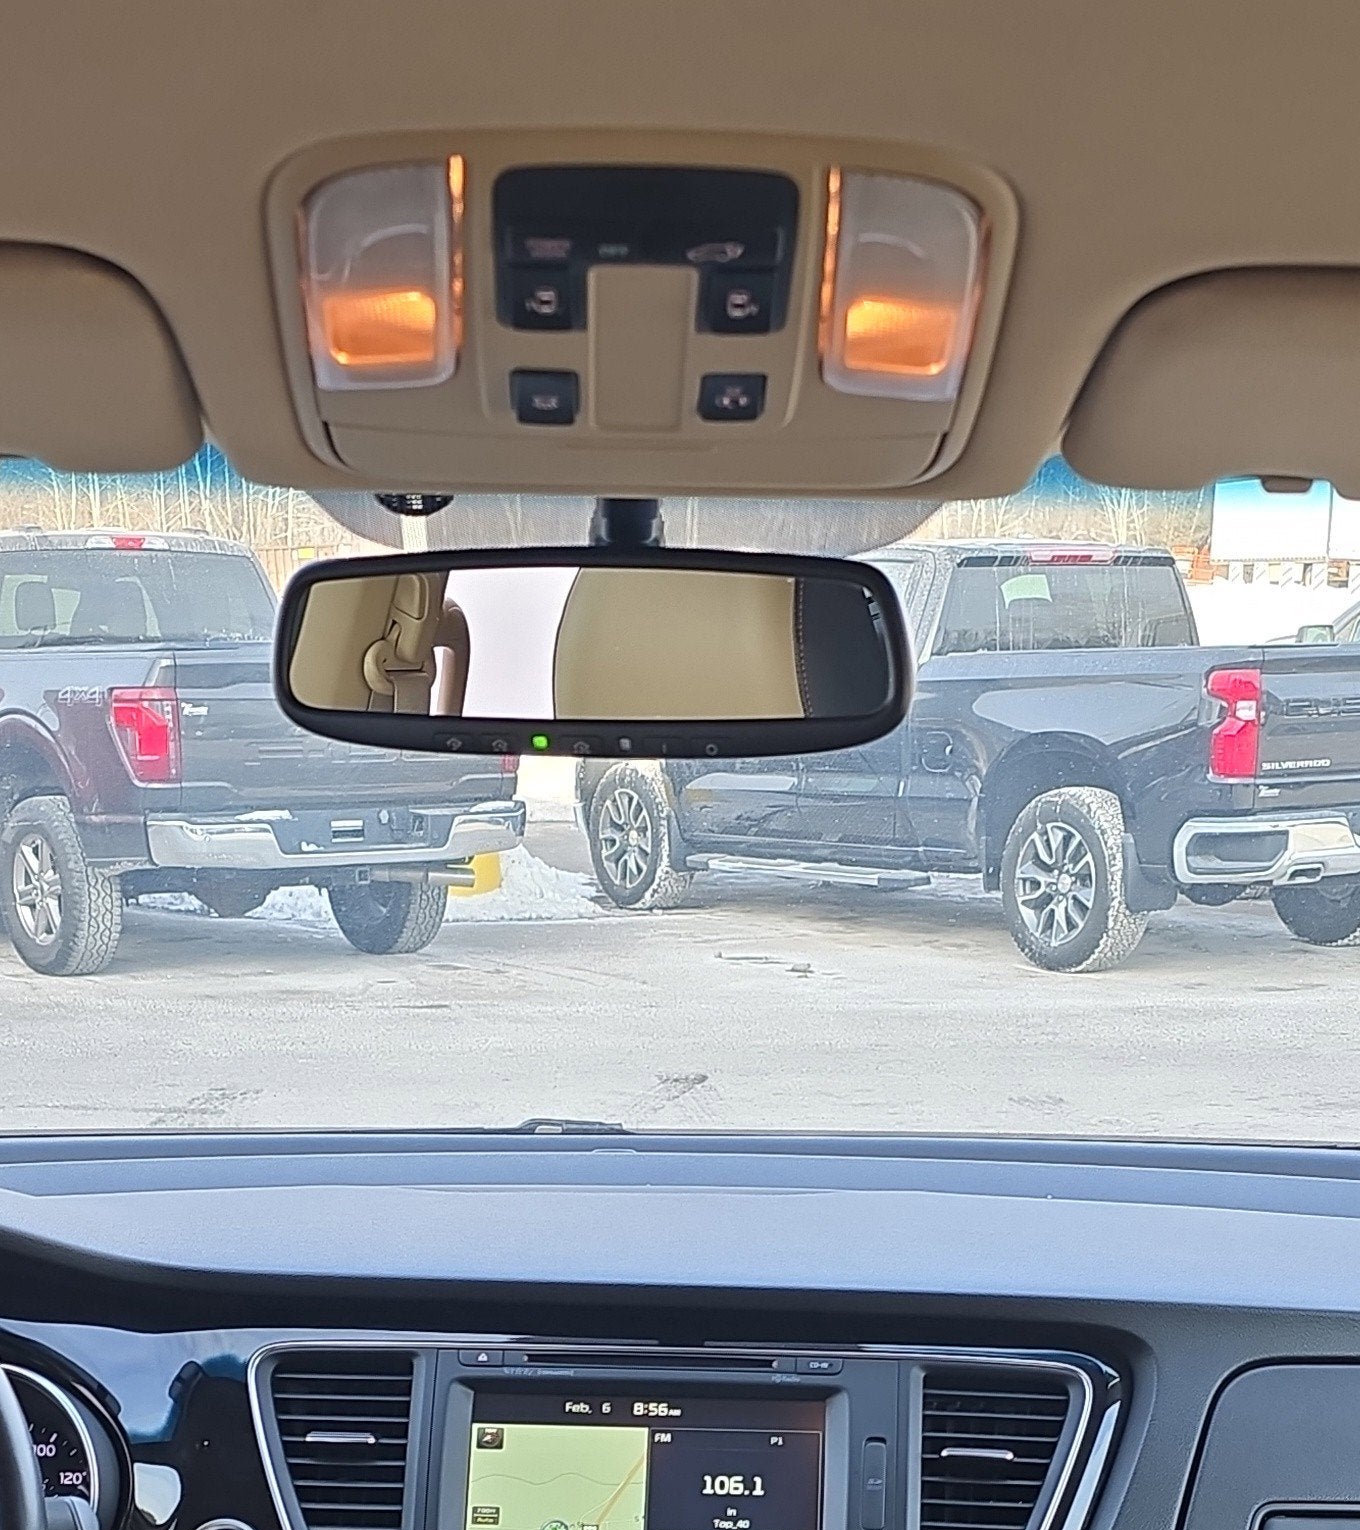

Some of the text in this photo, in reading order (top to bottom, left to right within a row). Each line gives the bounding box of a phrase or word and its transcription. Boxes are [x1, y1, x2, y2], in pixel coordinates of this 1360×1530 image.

[1261, 759, 1331, 770] SILVERADO
[602, 1402, 611, 1414] 6
[654, 1433, 672, 1443] FM
[59, 1471, 83, 1485] 120
[701, 1475, 765, 1497] 106.1
